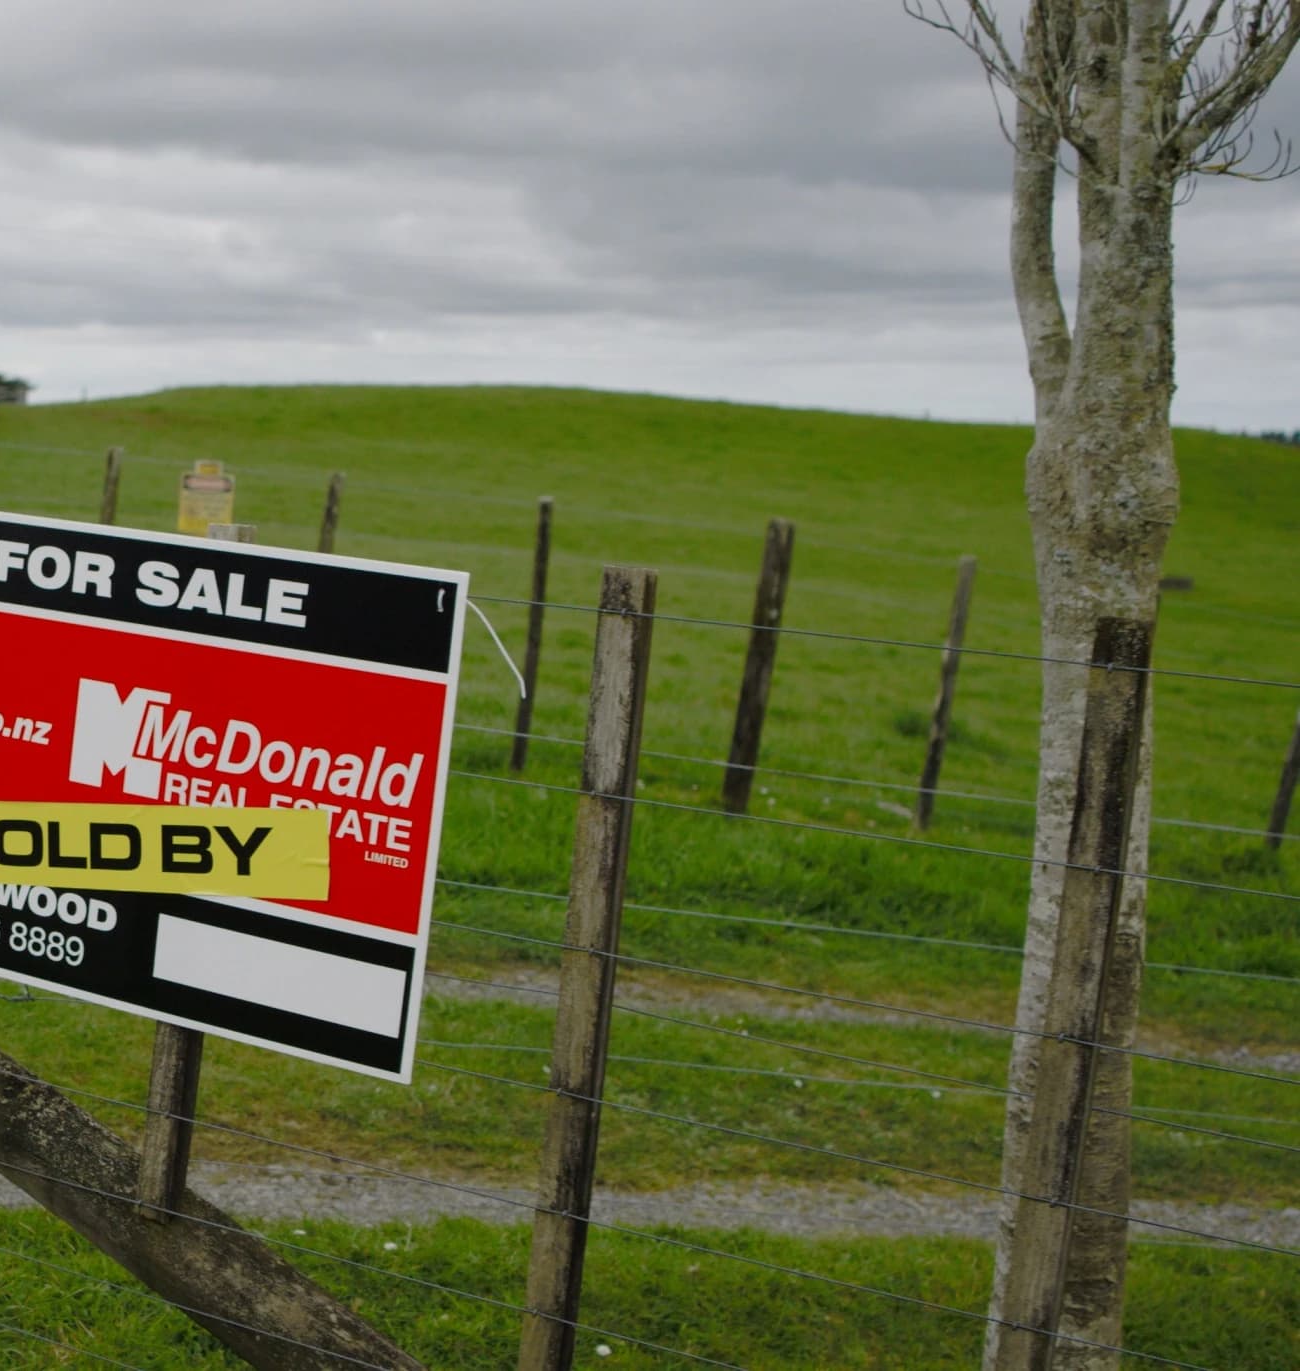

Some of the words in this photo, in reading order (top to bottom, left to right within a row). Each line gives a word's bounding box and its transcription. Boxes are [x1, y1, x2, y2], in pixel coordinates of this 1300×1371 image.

[136, 561, 309, 628] SALE
[137, 704, 424, 808] McDonald
[161, 825, 273, 876] BY
[364, 851, 408, 868] LIMITED
[9, 921, 85, 967] 8889
